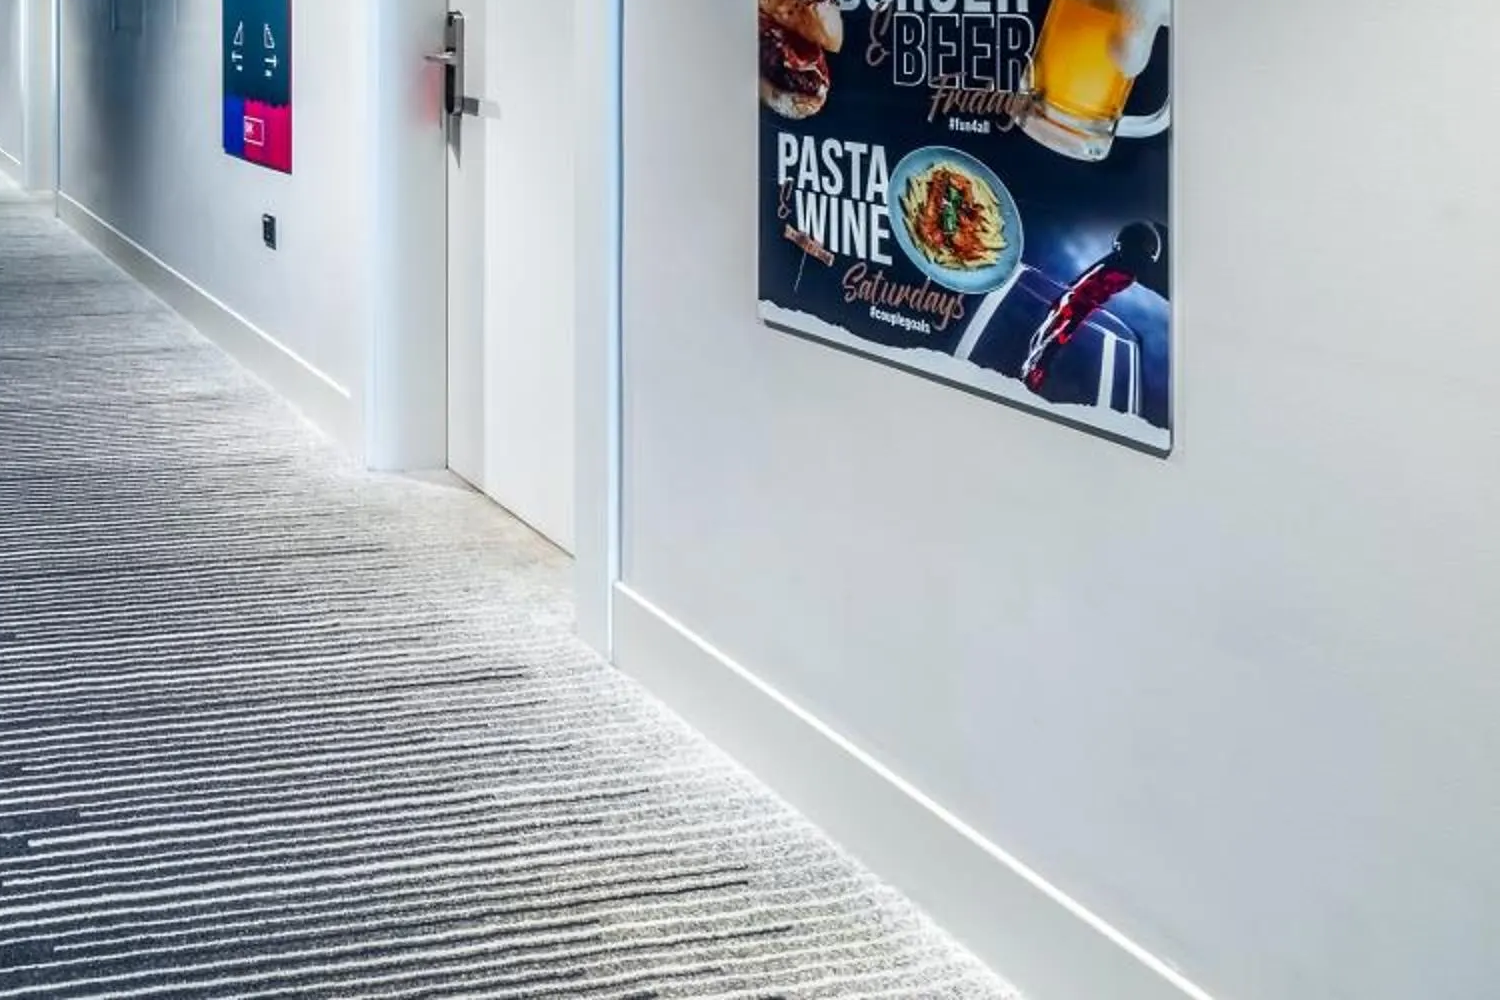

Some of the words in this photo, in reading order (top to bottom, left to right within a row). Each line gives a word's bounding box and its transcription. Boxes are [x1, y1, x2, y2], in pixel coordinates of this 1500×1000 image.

[893, 12, 1036, 94] BEER
[777, 131, 890, 204] PASTA
[795, 189, 893, 266] WINE
[841, 261, 965, 331] Saturdays
